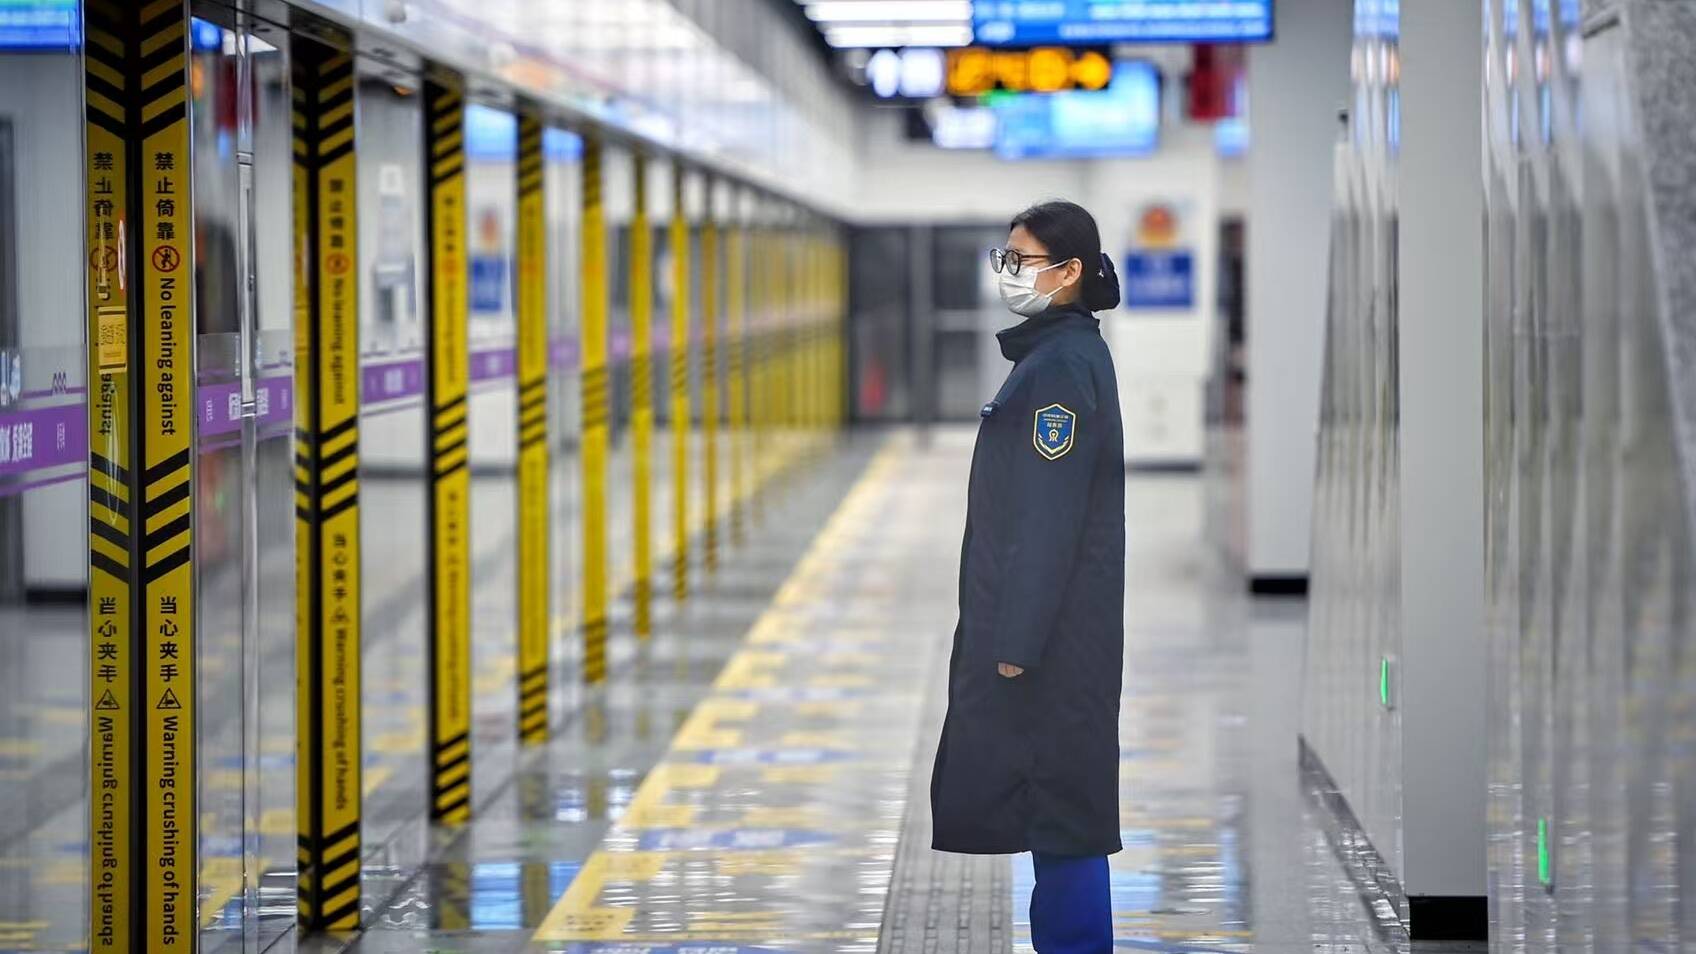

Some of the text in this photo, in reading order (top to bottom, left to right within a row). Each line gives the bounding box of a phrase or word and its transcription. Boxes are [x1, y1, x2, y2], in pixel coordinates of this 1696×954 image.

[154, 151, 176, 241] 禁止倚靠
[156, 277, 178, 436] No leaning against
[159, 595, 179, 683] 当心夹手
[331, 628, 349, 812] Warning crushing of hands
[158, 715, 180, 946] Warning crushing of hands
